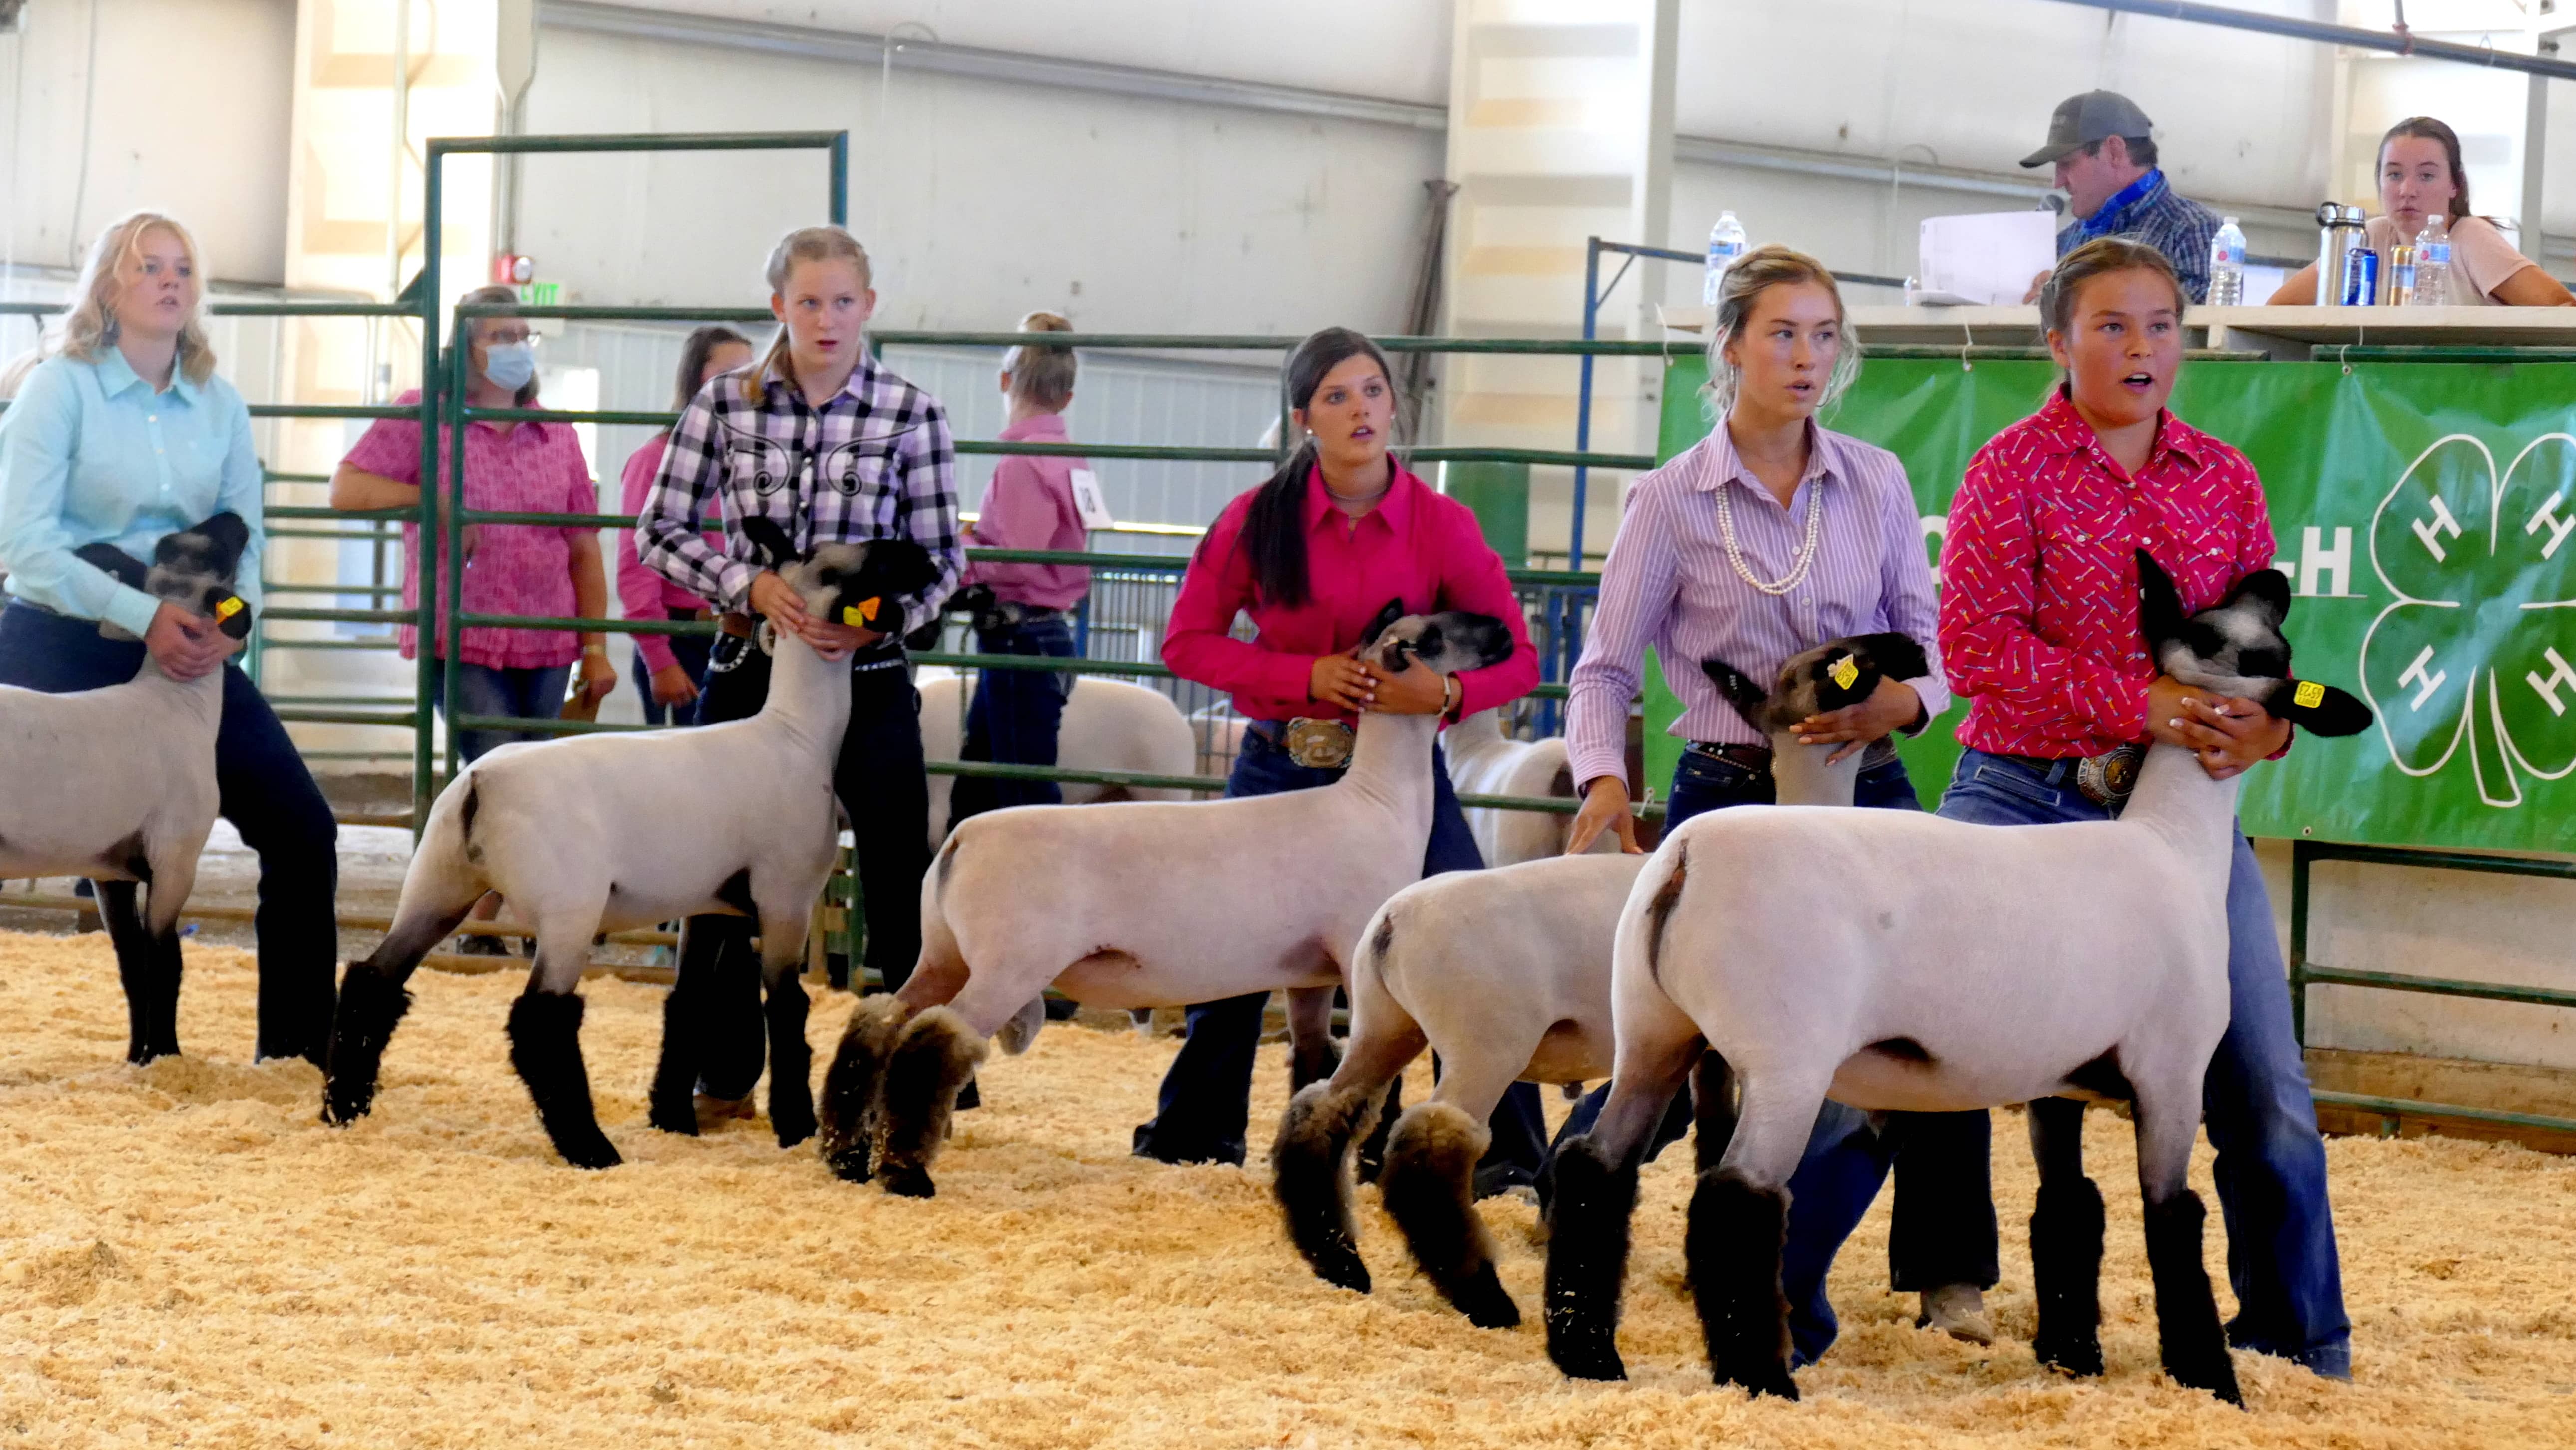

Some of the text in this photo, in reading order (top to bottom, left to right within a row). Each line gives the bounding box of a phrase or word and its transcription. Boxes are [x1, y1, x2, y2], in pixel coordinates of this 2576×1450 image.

[2273, 526, 2352, 596] -H
[2411, 494, 2462, 563] H
[2398, 644, 2446, 712] H
